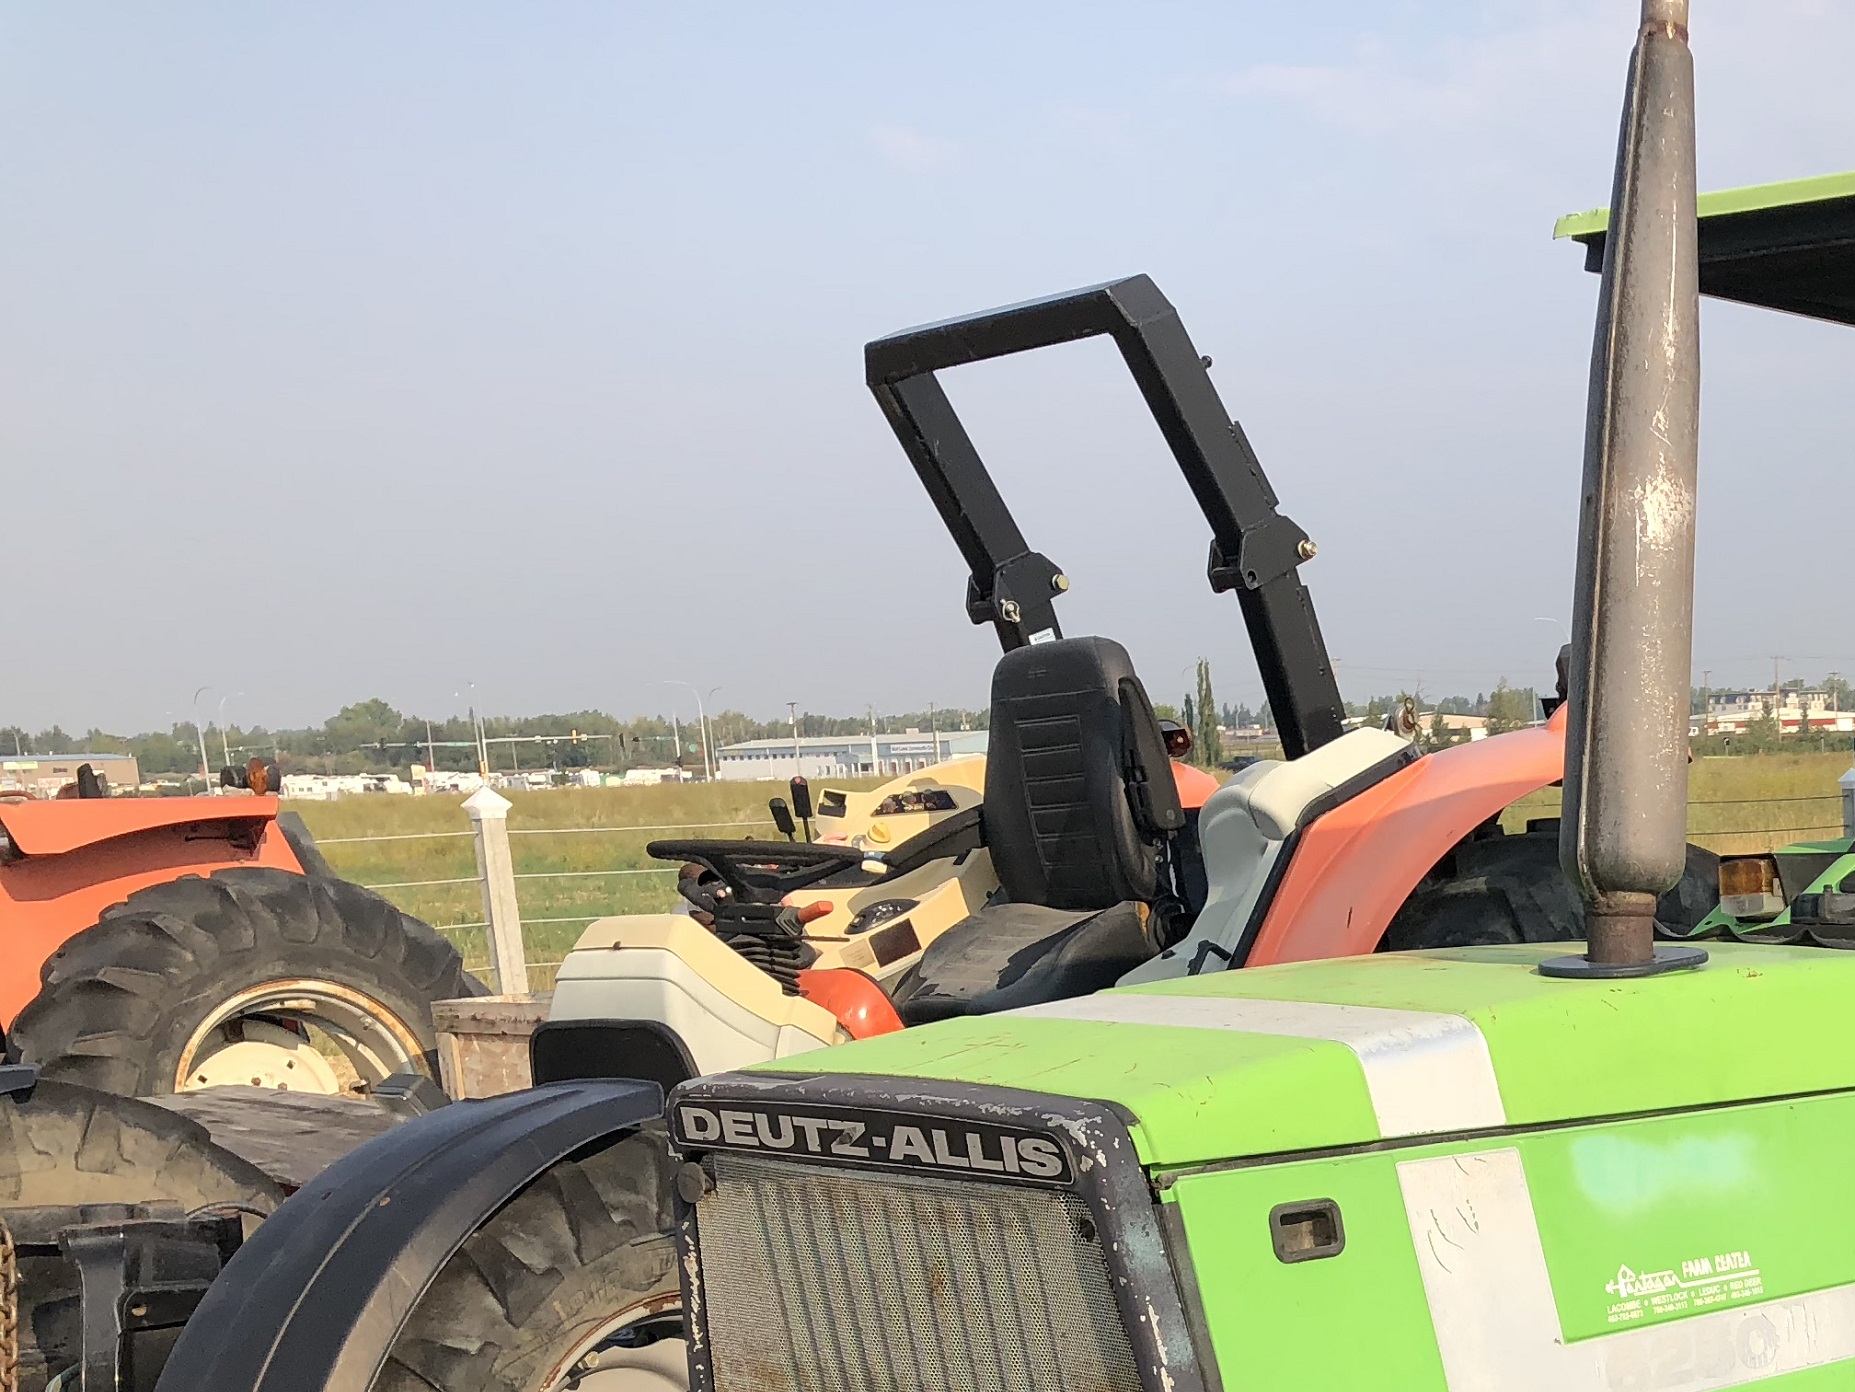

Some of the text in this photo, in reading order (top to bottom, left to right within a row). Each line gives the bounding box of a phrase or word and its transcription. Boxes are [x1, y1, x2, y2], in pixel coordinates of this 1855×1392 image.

[679, 1105, 1066, 1177] DEUTZ-ALLIS
[1681, 1256, 1713, 1278] FARM
[1606, 1276, 1762, 1314] LACOMBE WESTLOCK LEDUC RED DEER
